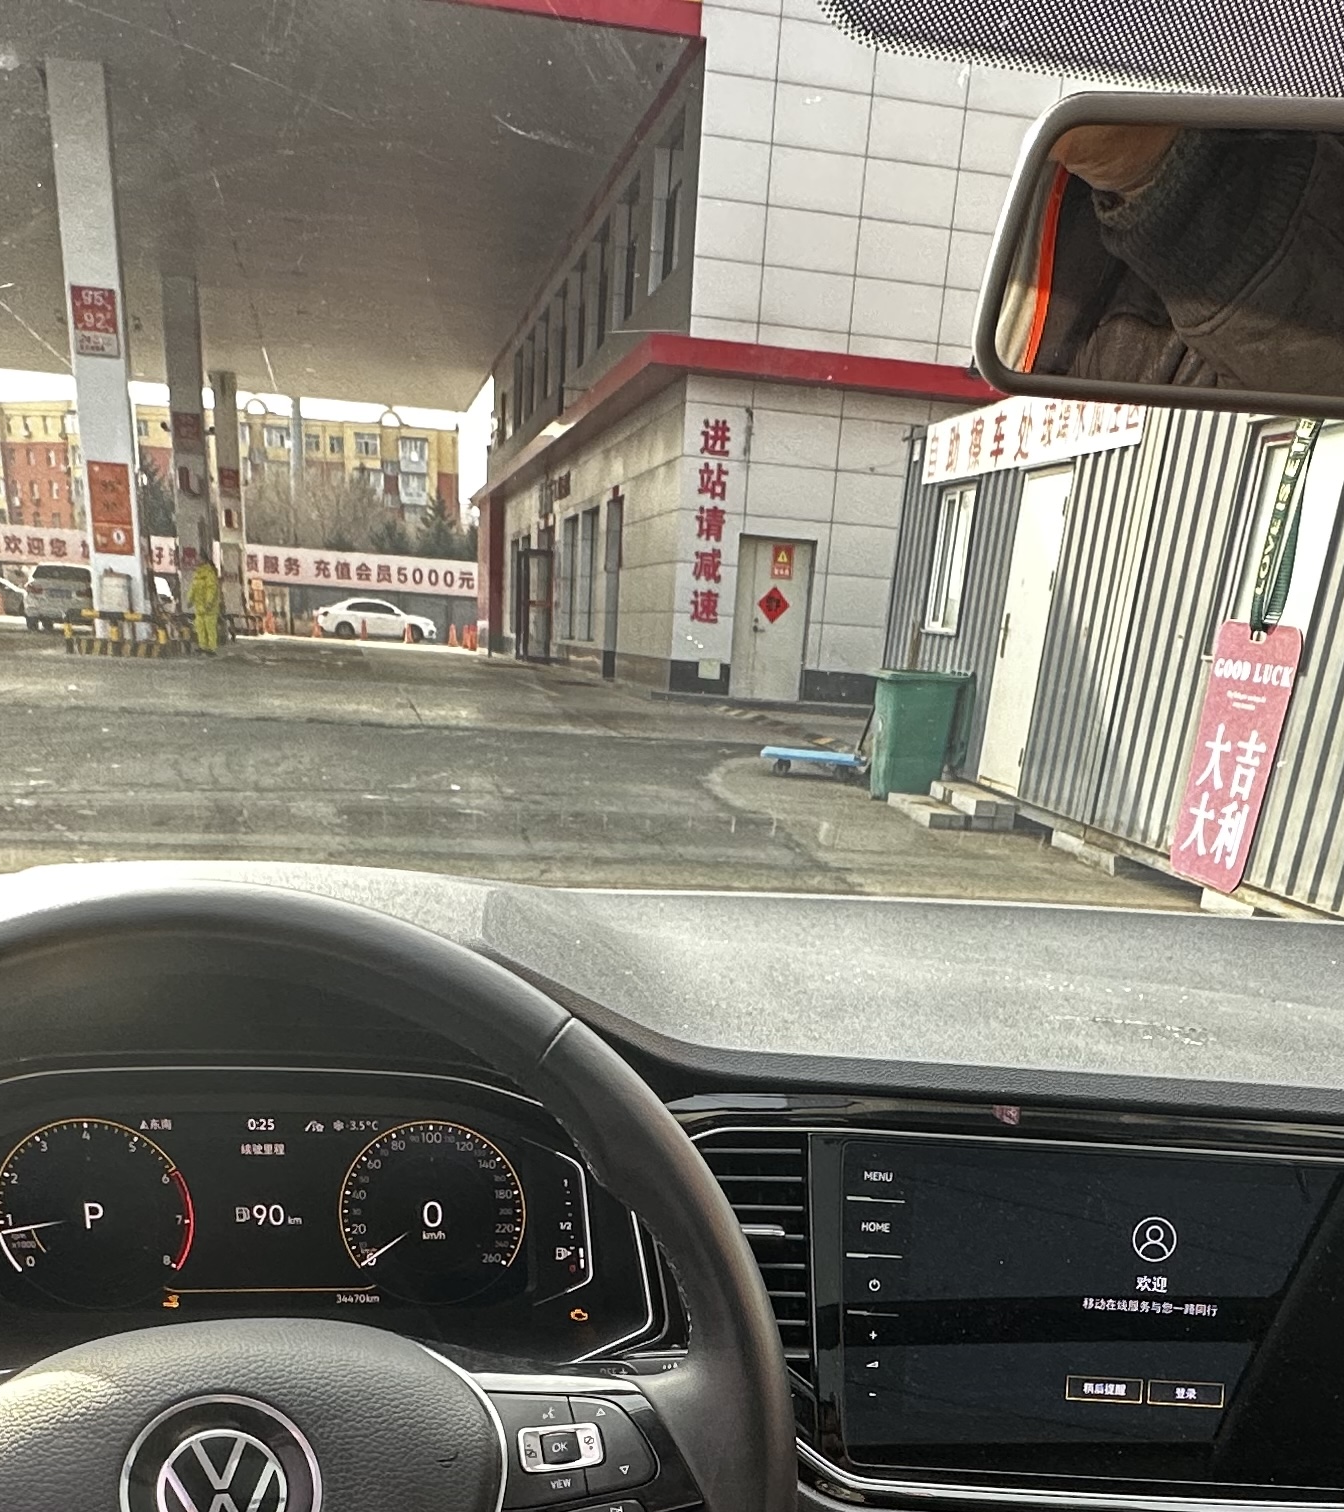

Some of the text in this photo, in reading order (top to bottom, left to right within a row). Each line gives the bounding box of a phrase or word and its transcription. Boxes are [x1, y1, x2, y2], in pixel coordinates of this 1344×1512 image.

[690, 418, 731, 624] 进站请减速
[1256, 518, 1284, 595] LOVE
[1275, 482, 1292, 512] IS
[313, 559, 476, 591] 充值会员5000元
[1214, 657, 1294, 688] GOOD LUCK
[1195, 723, 1267, 801] 大吉
[1179, 791, 1250, 871] 大利
[247, 1119, 275, 1131] 0:25
[82, 1130, 91, 1141] 4
[421, 1132, 442, 1143] 100
[40, 1142, 48, 1152] 3
[129, 1143, 137, 1153] 5
[391, 1140, 406, 1151] 80
[456, 1141, 474, 1152] 120
[367, 1159, 381, 1170] 60
[478, 1159, 496, 1169] 140
[10, 1173, 19, 1184] 2
[161, 1174, 170, 1184] 6
[864, 1170, 894, 1182] MENU
[351, 1189, 367, 1200] 40
[494, 1189, 513, 1200] 180
[82, 1202, 104, 1229] P
[175, 1215, 182, 1225] 7
[252, 1204, 303, 1226] 90 km
[422, 1201, 443, 1228] 0
[351, 1223, 367, 1234] 20
[495, 1223, 514, 1234] 220
[559, 1221, 573, 1231] 1/2
[861, 1221, 891, 1233] HOME
[422, 1231, 446, 1240] km/h
[25, 1256, 35, 1267] 0
[163, 1256, 171, 1265] 8
[482, 1253, 501, 1263] 260
[1136, 1276, 1168, 1293] 欢迎
[1082, 1297, 1219, 1317] 移动在线服务与您一路同行
[1175, 1388, 1198, 1400] 登录
[551, 1441, 569, 1453] OK
[551, 1478, 572, 1490] VIEW
